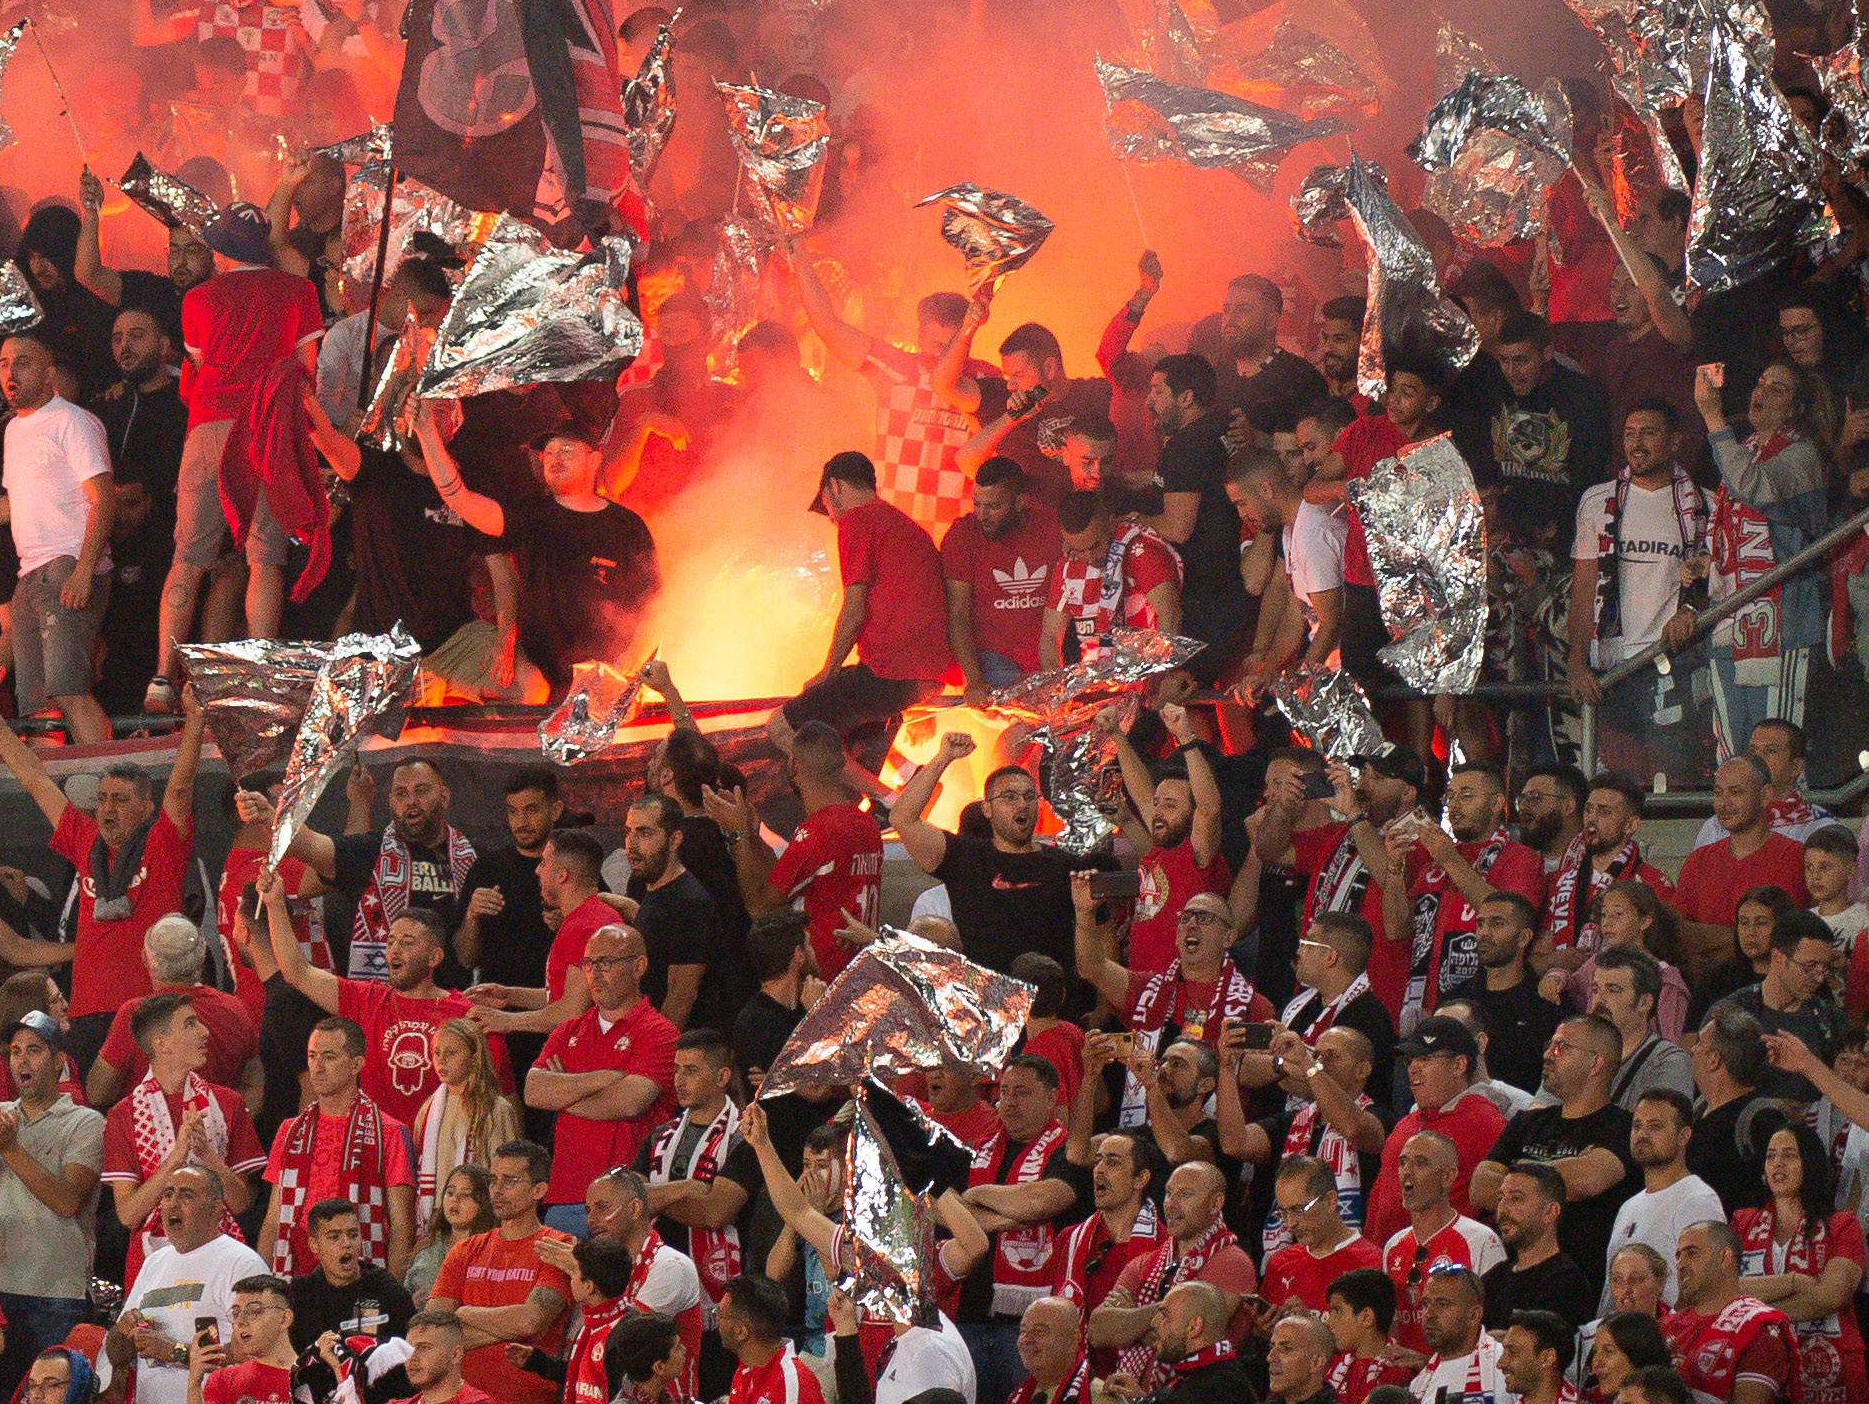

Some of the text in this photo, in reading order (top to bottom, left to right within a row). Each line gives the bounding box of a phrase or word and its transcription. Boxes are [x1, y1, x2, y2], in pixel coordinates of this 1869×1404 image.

[1618, 540, 1686, 557] TADIRA
[994, 596, 1046, 610] adidas
[412, 876, 454, 893] BALL
